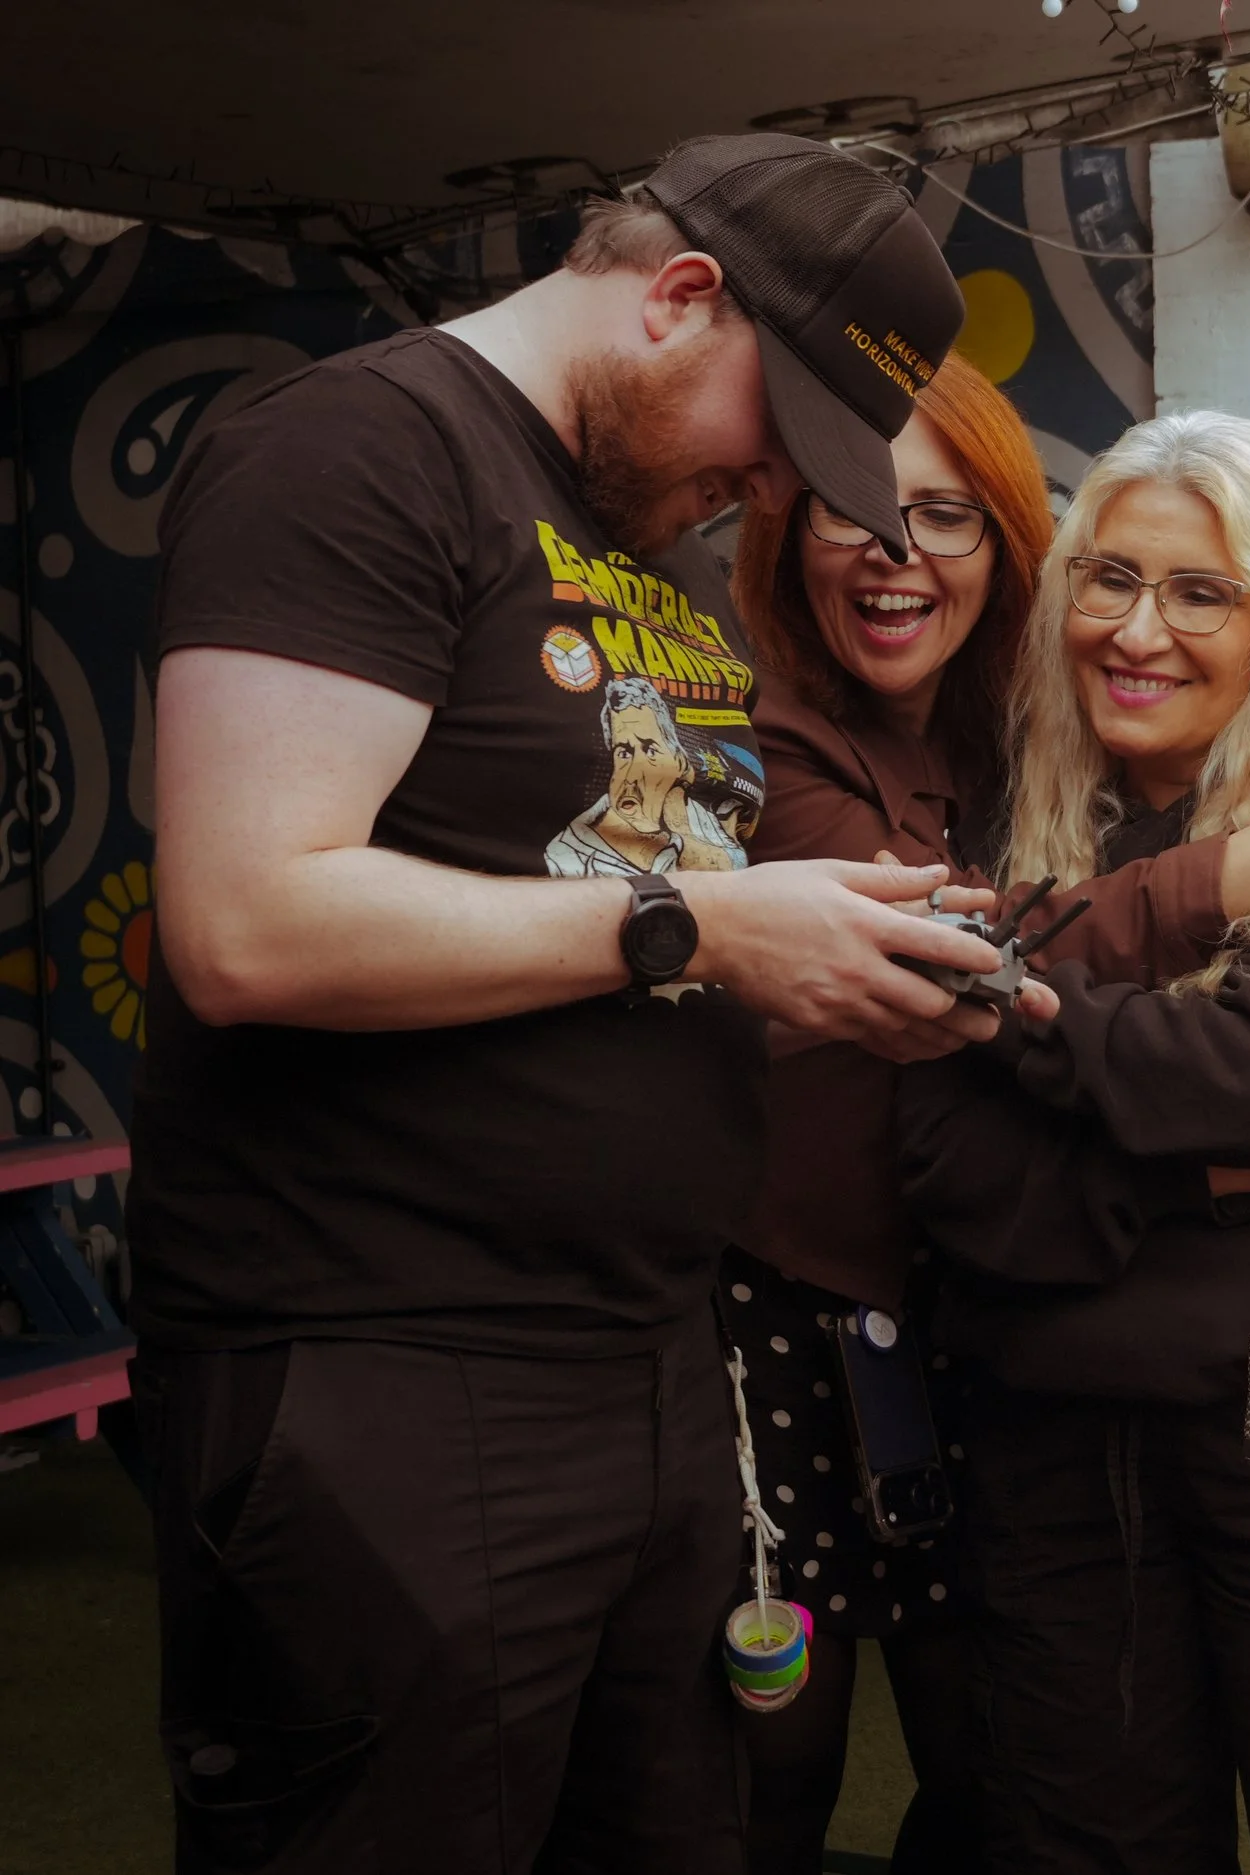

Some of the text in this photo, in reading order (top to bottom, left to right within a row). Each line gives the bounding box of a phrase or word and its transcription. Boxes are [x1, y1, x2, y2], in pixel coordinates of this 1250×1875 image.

[843, 321, 916, 397] HORIZONTAL
[883, 328, 921, 366] MAKE
[534, 519, 732, 652] DEMOCRACY
